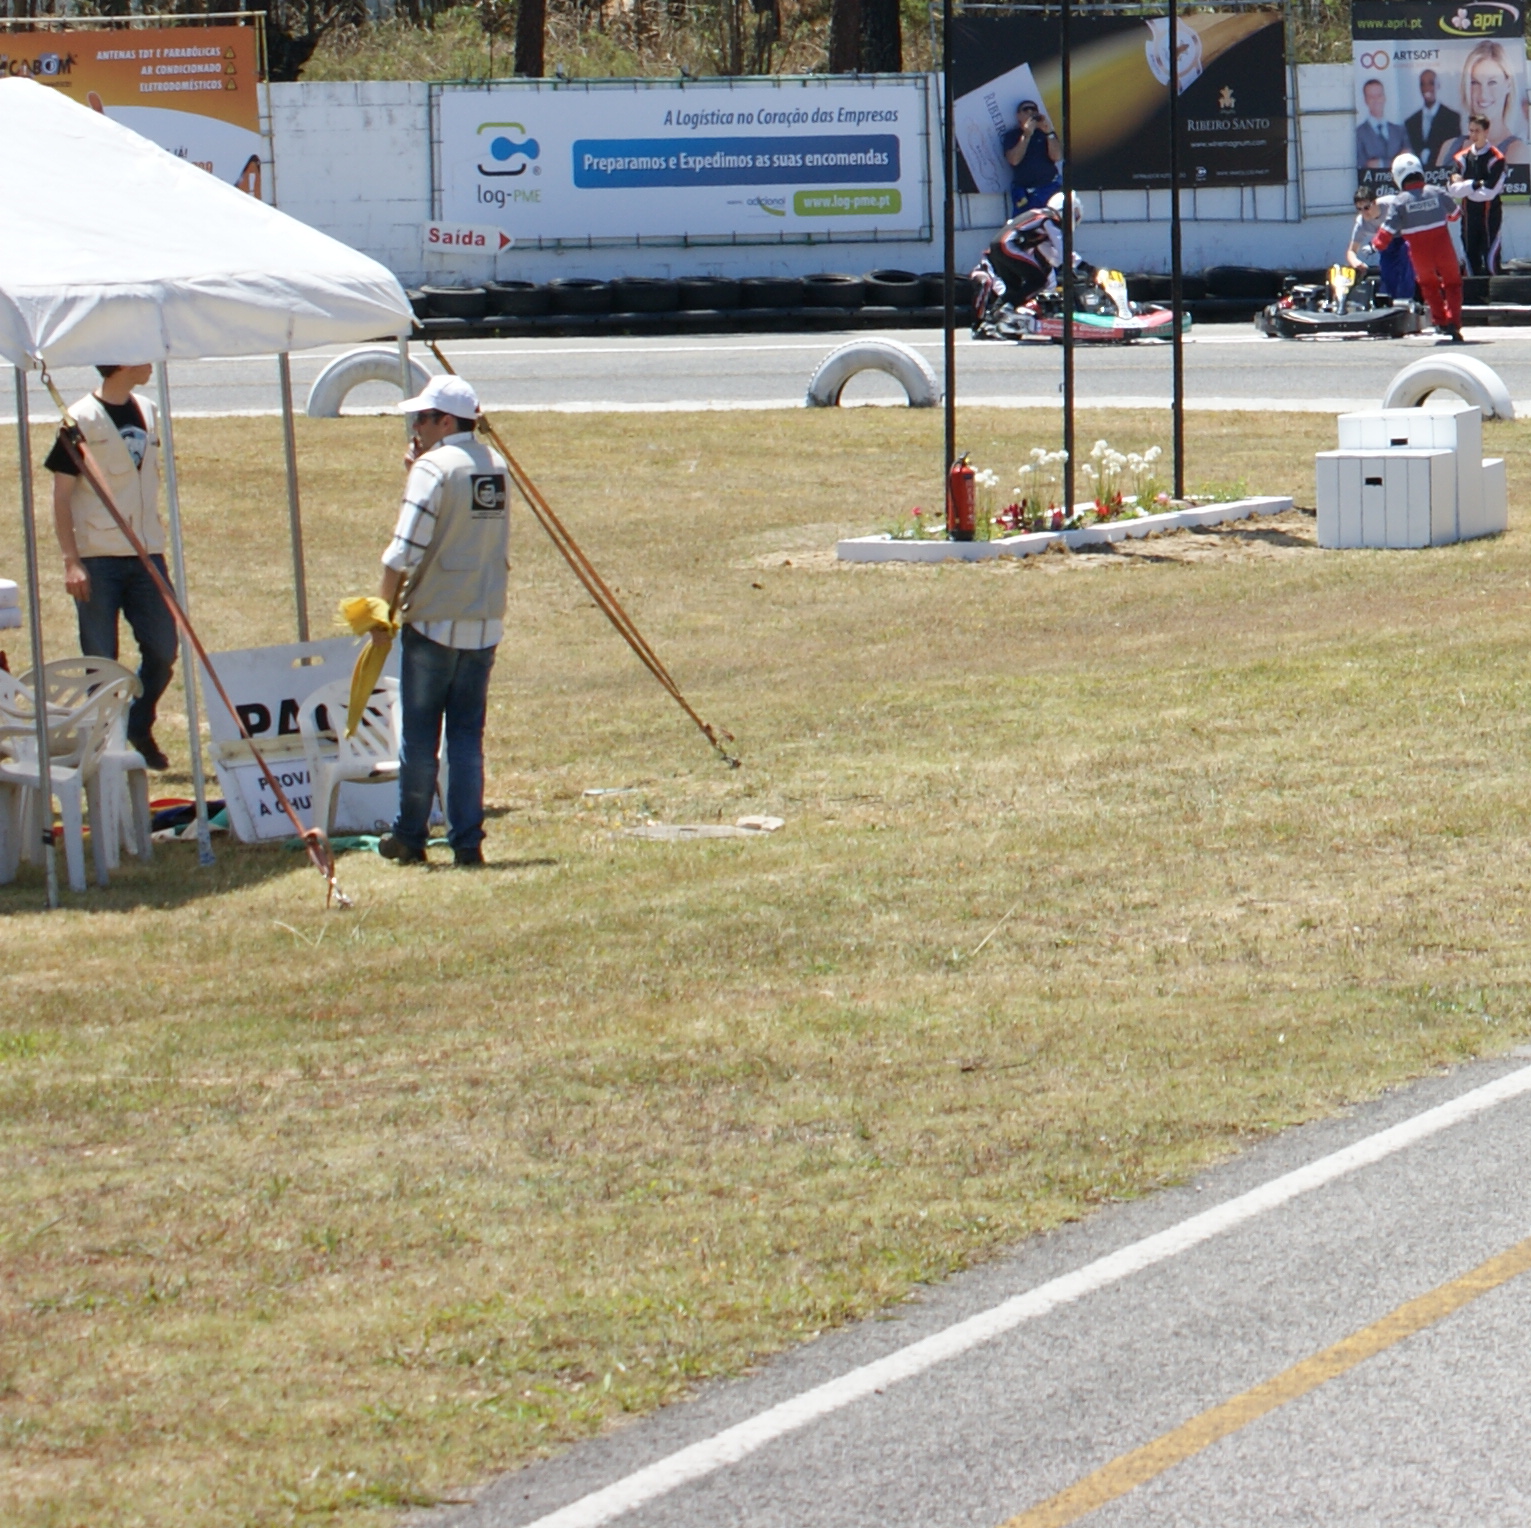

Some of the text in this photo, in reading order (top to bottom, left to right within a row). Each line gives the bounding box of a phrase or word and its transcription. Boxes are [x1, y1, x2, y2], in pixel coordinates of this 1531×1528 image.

[1357, 9, 1504, 34] www.apri.pt apri
[96, 50, 136, 61] ANTENAS
[163, 46, 222, 59] PARABÓLICAS
[1393, 49, 1440, 61] ARTSOFT
[141, 63, 222, 75] AR CONDICIONADO
[139, 79, 224, 92] ELETRODOMÉSTICOS
[664, 106, 899, 130] A Logística no Coração das Empresas
[1187, 117, 1270, 132] RIBEIRO SANTO
[584, 149, 889, 174] Preparamos e Expedimos as suas encomendas
[1363, 171, 1374, 183] A
[477, 184, 542, 209] log-PME
[803, 194, 890, 211] www.log-pme.pt
[428, 227, 486, 247] Saída
